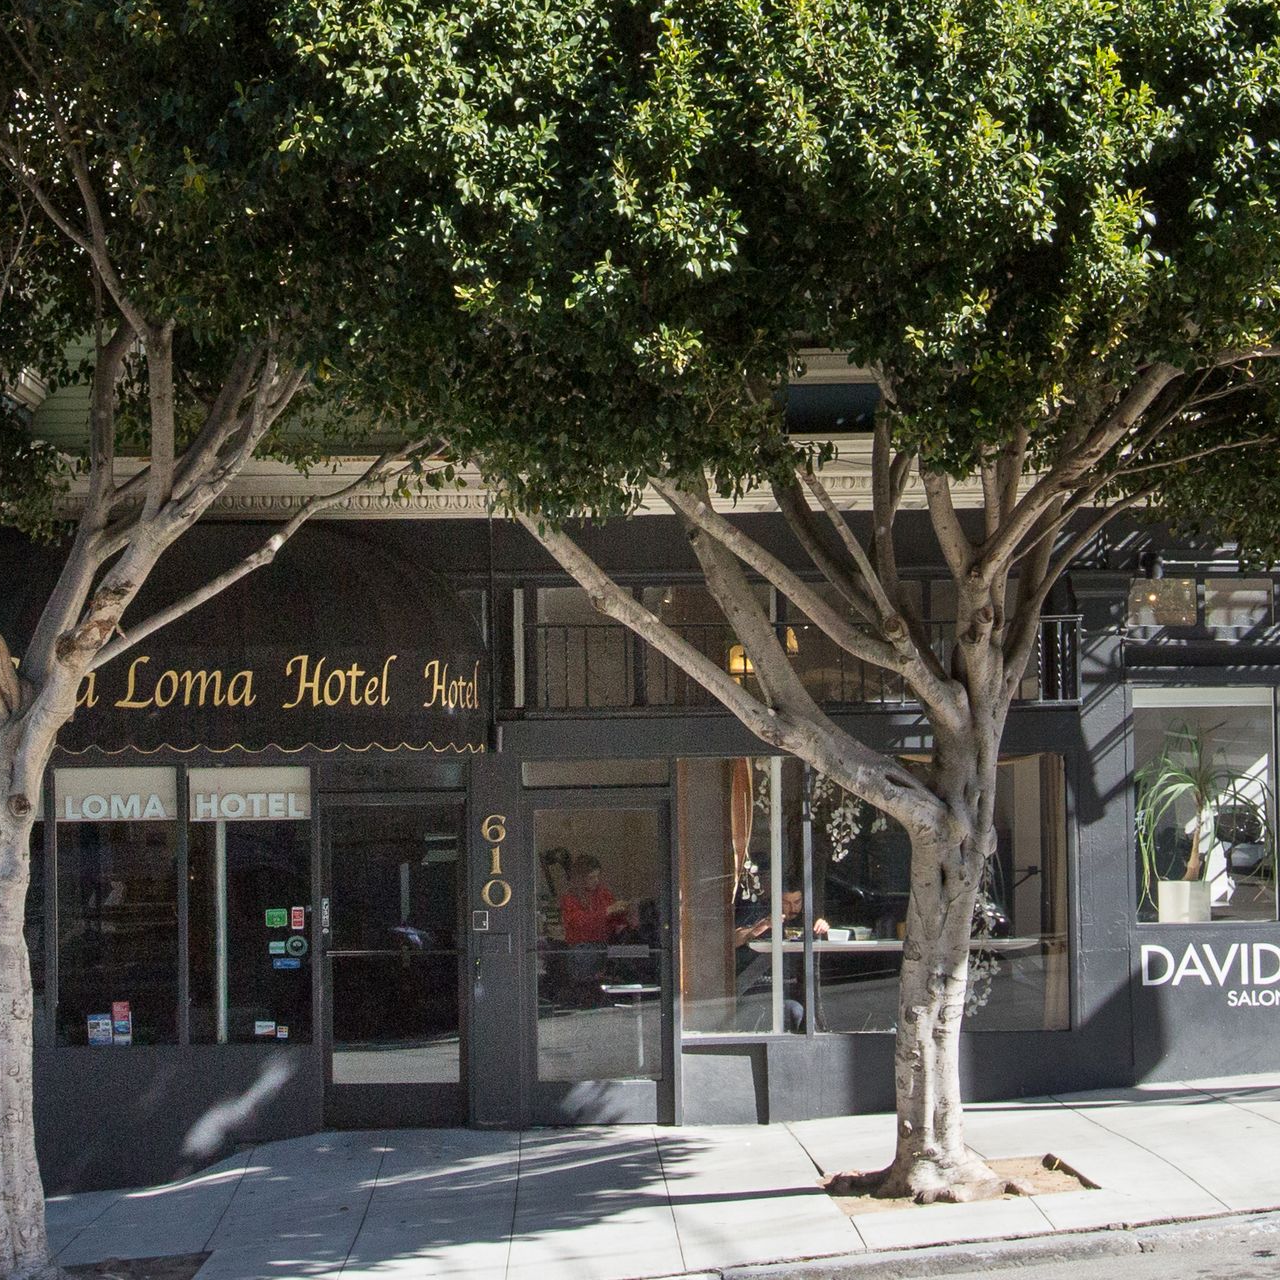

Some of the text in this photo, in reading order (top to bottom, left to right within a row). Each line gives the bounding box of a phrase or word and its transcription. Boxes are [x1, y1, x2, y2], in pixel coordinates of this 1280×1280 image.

[114, 655, 257, 708] Loma
[282, 654, 397, 709] Hotel
[423, 660, 480, 710] Hotel
[65, 792, 305, 821] LOMA HOTEL
[481, 814, 513, 908] 610
